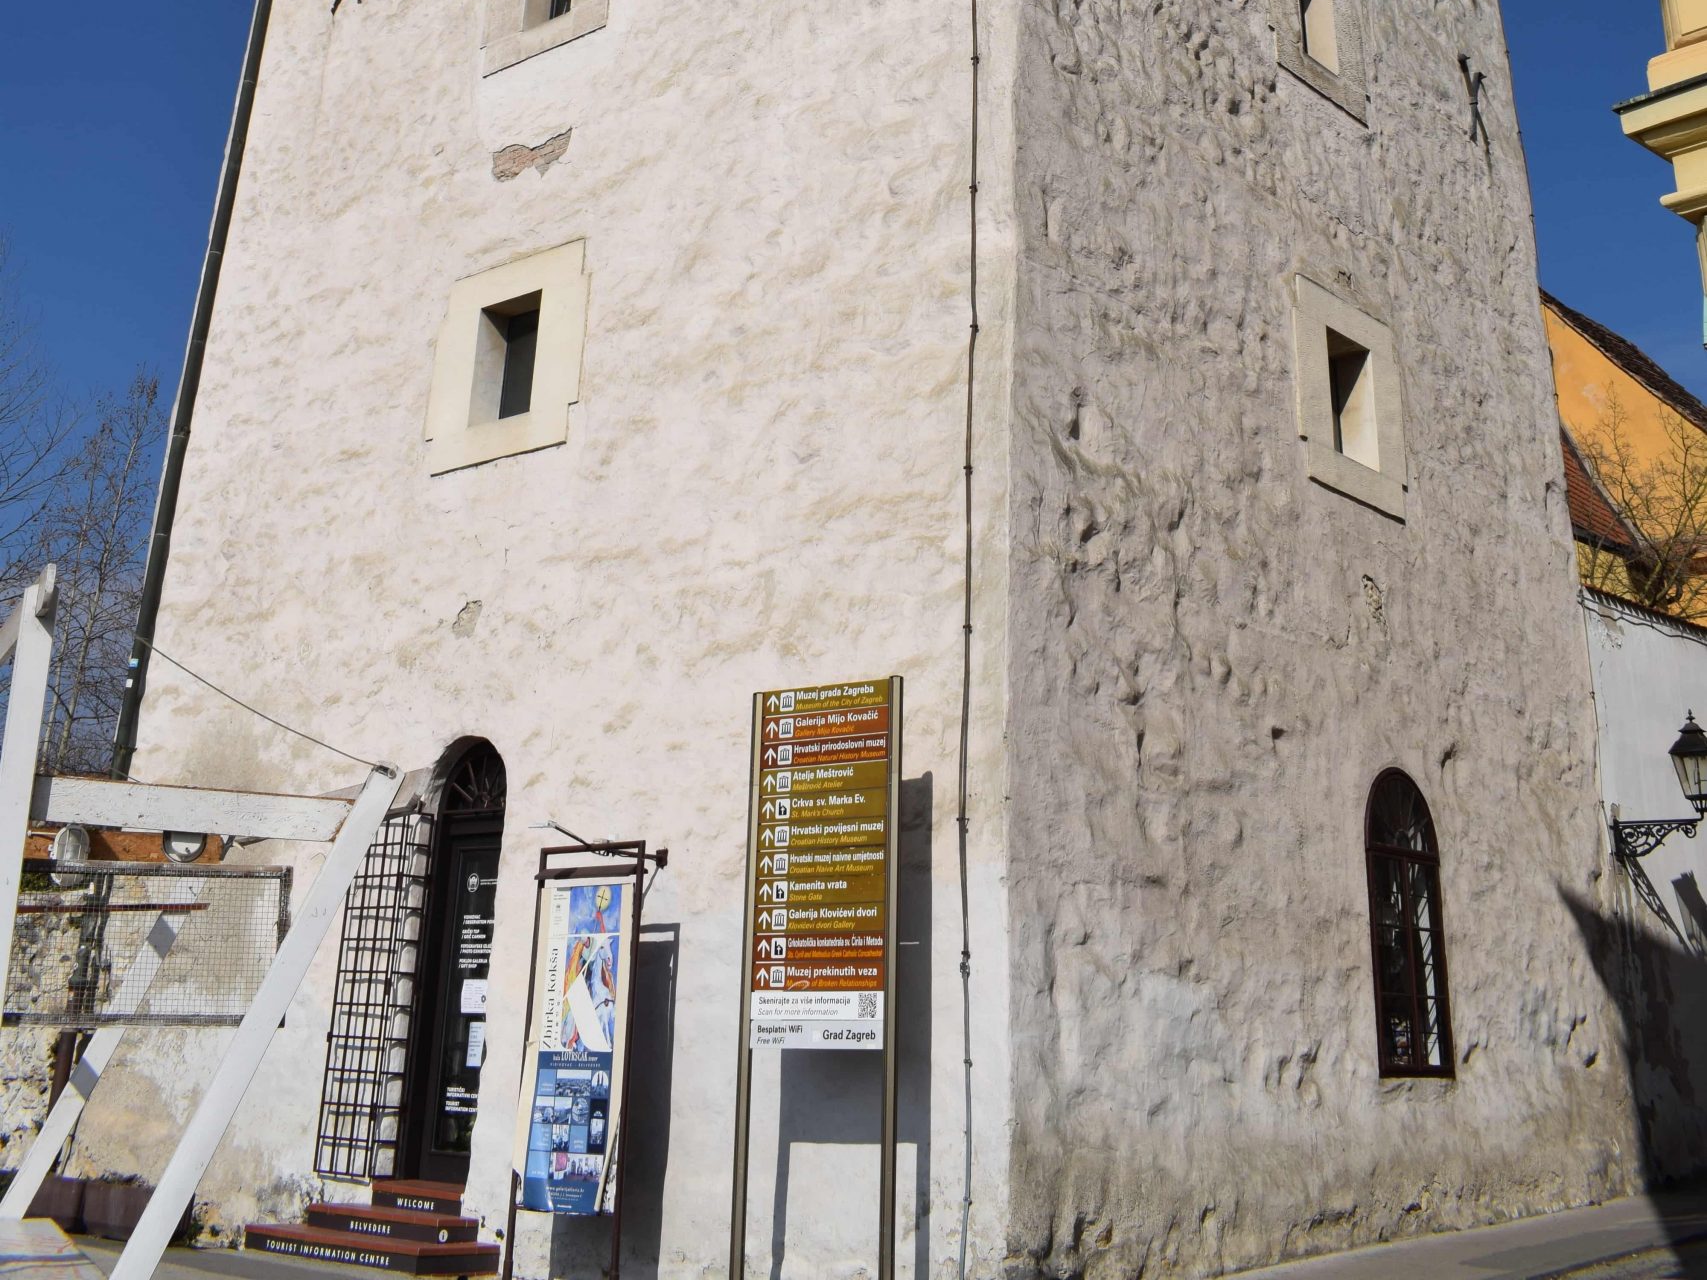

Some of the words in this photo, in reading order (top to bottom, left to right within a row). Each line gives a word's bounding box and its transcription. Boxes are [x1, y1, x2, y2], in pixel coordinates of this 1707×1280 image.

[796, 690, 818, 701] Muzej
[820, 688, 841, 699] grada
[843, 685, 874, 696] Zagreba
[796, 702, 821, 710] Museum
[841, 698, 853, 706] City
[861, 696, 882, 704] Zagreb
[796, 716, 825, 727] Galerija
[828, 714, 845, 725] Mijo
[848, 710, 878, 722] Kovačić
[795, 729, 815, 737] Gallery
[818, 728, 830, 736] Mijo
[794, 743, 820, 754] Hrvatski
[822, 739, 864, 752] prirodoslovni
[866, 737, 886, 747] muzej
[794, 756, 817, 764] Croatian
[818, 754, 838, 762] Natural
[840, 752, 859, 761] History
[861, 750, 886, 758] Museum
[793, 771, 814, 781] Atelje
[817, 766, 853, 779] Meštrović
[792, 799, 813, 808] Crkva
[829, 795, 852, 805] Marka
[855, 794, 866, 803] Ev.
[822, 808, 844, 816] Church
[791, 824, 822, 835] Hrvatski
[824, 822, 858, 835] povijesni
[861, 820, 883, 832] muzej
[817, 836, 838, 845] History
[790, 853, 813, 863] Hrvatski
[814, 852, 832, 864] muzej
[832, 852, 851, 862] naivne
[853, 850, 884, 862] umjetnosti
[816, 865, 833, 873] Naive
[835, 864, 844, 872] Art
[846, 864, 873, 872] Museum
[790, 880, 825, 891] Kamenita
[827, 880, 847, 888] vrata
[789, 909, 818, 920] Galerija
[820, 907, 854, 918] Klovićevi
[857, 906, 877, 917] dvori
[816, 921, 832, 929] dvori
[833, 921, 855, 929] Gallery
[866, 936, 883, 946] Metoda
[787, 967, 811, 978] Muzej
[814, 966, 856, 978] prekinutih
[840, 980, 877, 988] Relationships
[759, 997, 789, 1006] Skenirajte
[801, 996, 813, 1004] više
[814, 996, 850, 1006] informacija
[773, 1008, 783, 1017] for
[758, 1025, 786, 1035] Besplatni
[789, 1025, 803, 1033] WiFi
[823, 1030, 843, 1040] Grad
[846, 1030, 876, 1042] Zagreb
[397, 1198, 434, 1210] WELCOME
[350, 1221, 391, 1234] BELVEDERE
[266, 1239, 297, 1252] TOURIST
[300, 1245, 355, 1261] INFORMATION
[360, 1253, 389, 1266] CENTRE
